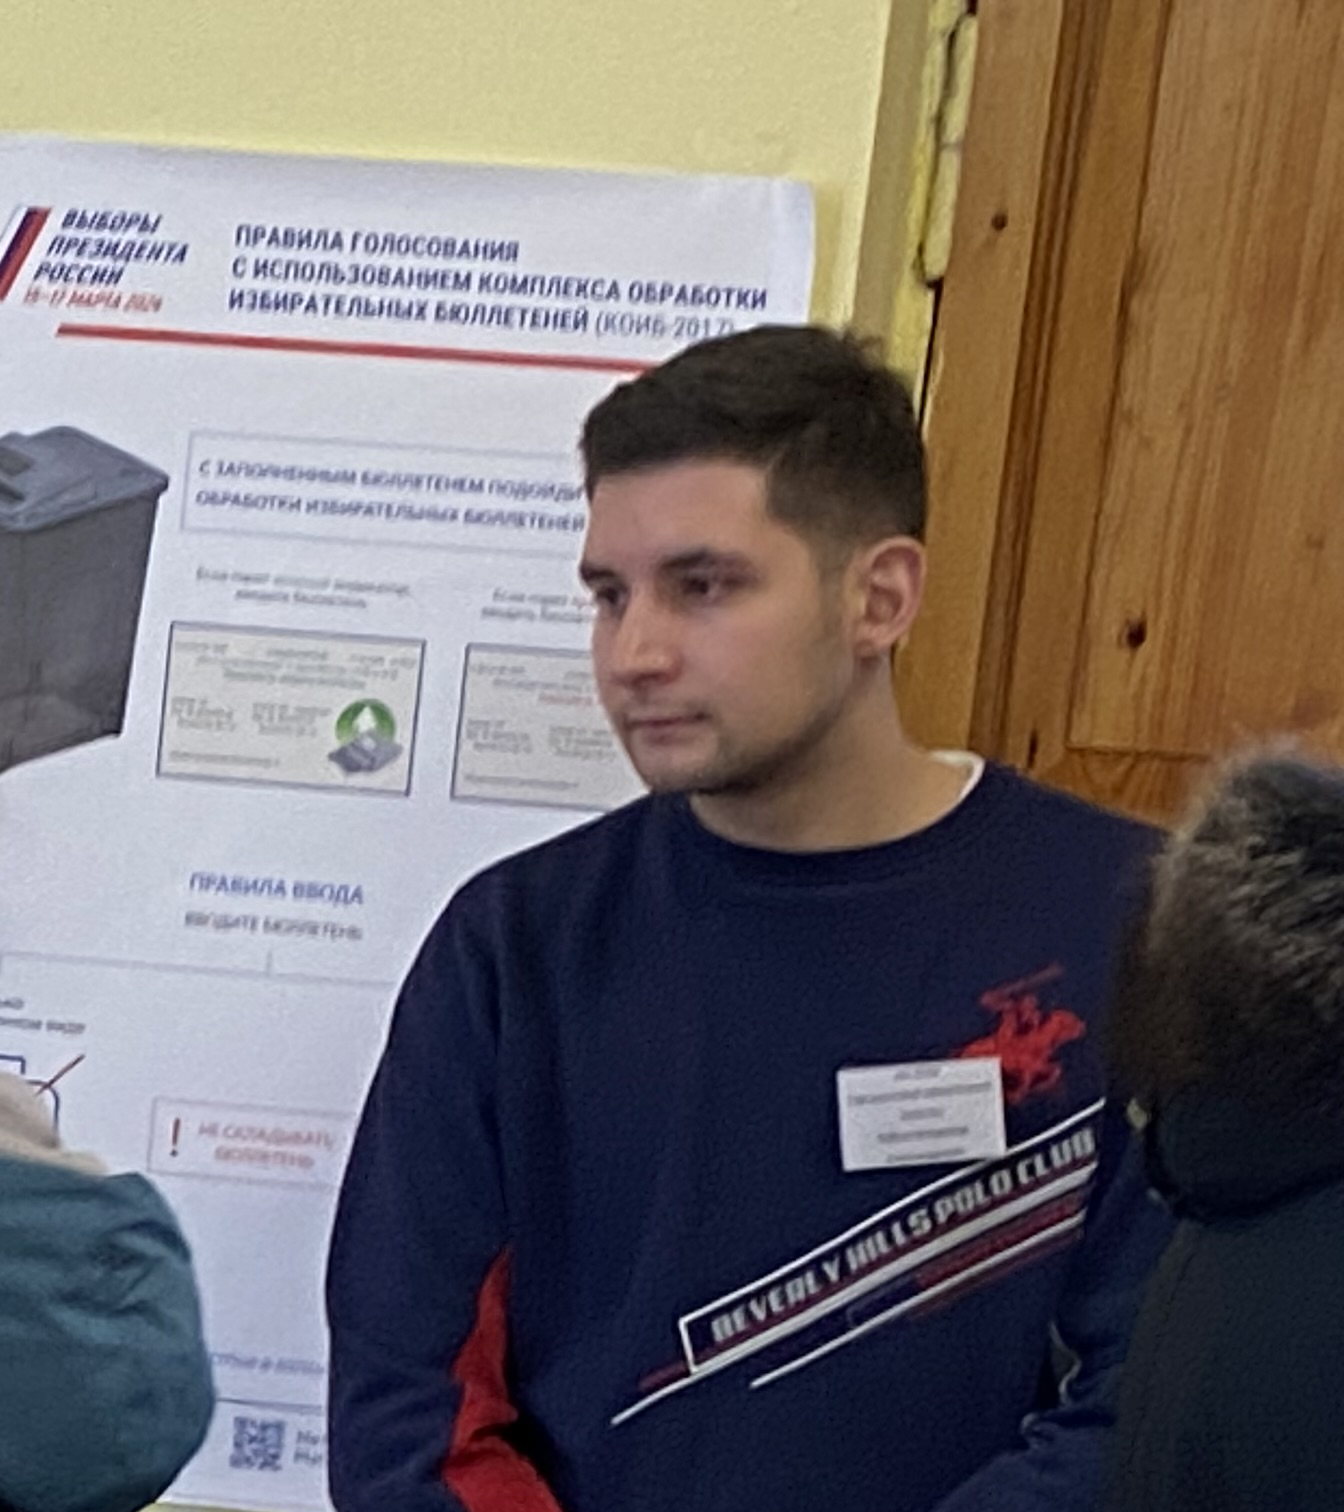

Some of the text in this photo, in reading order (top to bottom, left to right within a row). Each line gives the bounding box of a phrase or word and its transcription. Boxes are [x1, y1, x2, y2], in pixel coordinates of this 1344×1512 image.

[62, 208, 162, 235] ВЫБОРЫ
[46, 235, 189, 264] ПРЕЗИДЕНТА
[235, 224, 519, 262] ПРАВИЛА ГОЛОСОВАНИЯ
[33, 262, 124, 286] РОССИИ
[232, 257, 767, 310] С ИСПОЛЬЗОВАНИЕМ КОМПЛЕКСА ОБРАБОТКИ
[228, 289, 427, 321] ИЗБИРАТЕЛЬНЫХ
[434, 301, 589, 332] БЮЛЛЕТЕНЕЙ
[190, 872, 363, 907] ПРАВИЛА ВВОДА
[712, 1127, 1096, 1343] BEVERLY HILLS POLO CLUB
